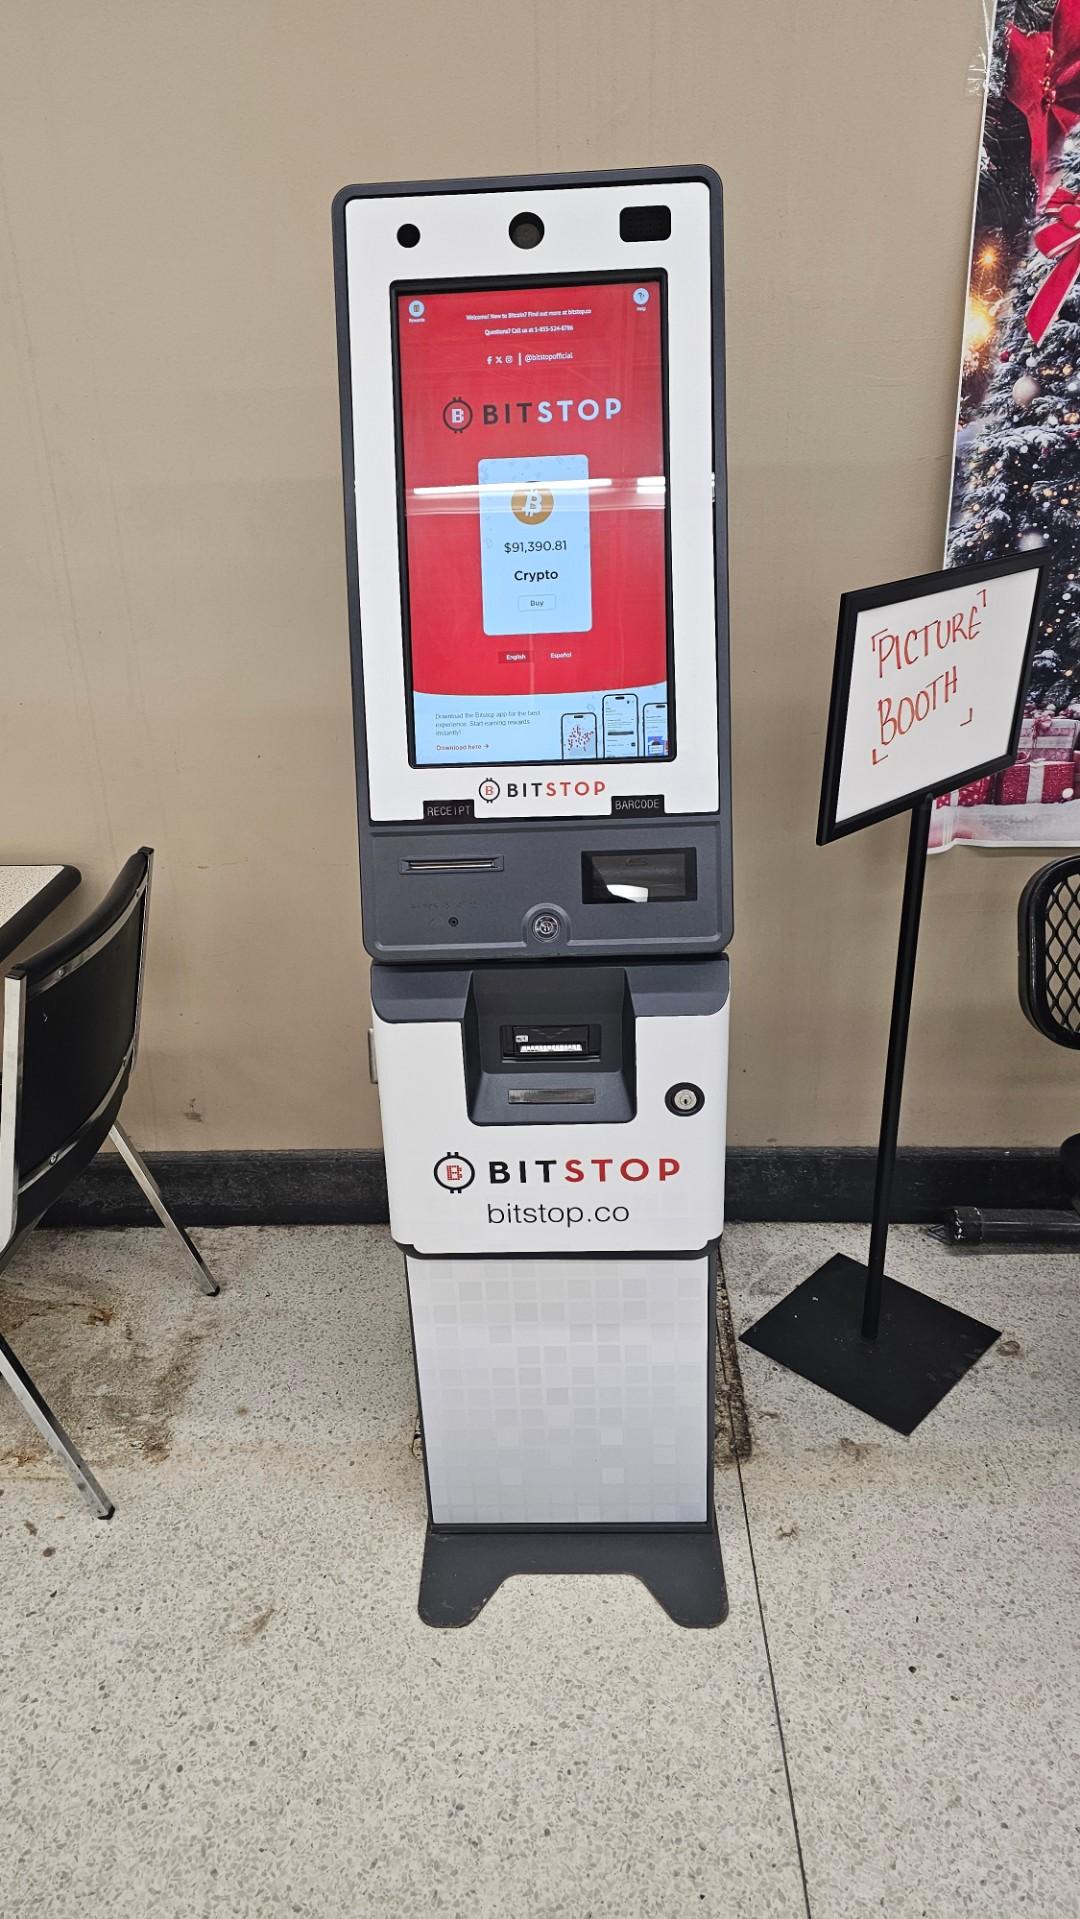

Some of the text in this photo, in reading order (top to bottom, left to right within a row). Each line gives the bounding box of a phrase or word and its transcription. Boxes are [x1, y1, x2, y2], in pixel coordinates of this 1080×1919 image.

[465, 313, 490, 321] Welcome!
[508, 311, 527, 319] Bitcoin?
[484, 327, 511, 336] Questions?
[511, 326, 521, 334] Call
[524, 352, 573, 363] @bitstopofficial
[482, 397, 622, 425] BITSTOP
[504, 540, 567, 554] $91,390.81
[514, 569, 558, 582] Crypto
[878, 605, 982, 679] PICTURE
[506, 653, 526, 661] English
[877, 664, 958, 746] BOOTH
[435, 712, 464, 720] Download
[474, 711, 495, 719] Bitstop
[496, 711, 508, 719] app
[484, 719, 506, 727] earning
[506, 780, 606, 798] BITSTOP
[615, 798, 660, 810] BARCODE
[427, 806, 472, 817] RECEIPT
[488, 1157, 681, 1185] BITSTOP
[487, 1202, 630, 1228] bitstop.co
